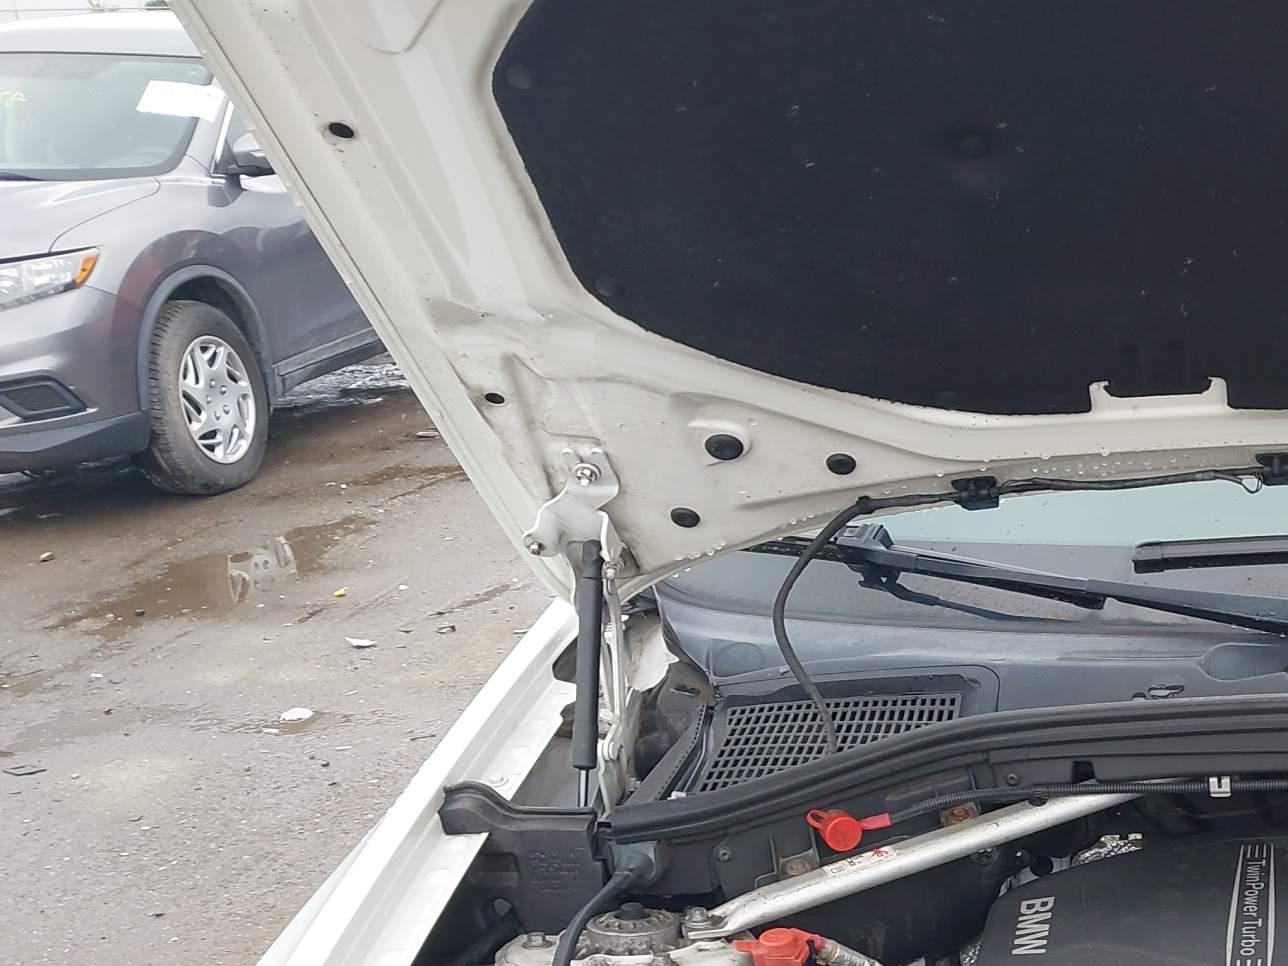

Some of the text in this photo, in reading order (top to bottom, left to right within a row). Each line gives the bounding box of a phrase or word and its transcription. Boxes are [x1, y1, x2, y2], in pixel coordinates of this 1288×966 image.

[1011, 896, 1055, 955] BMW
[1240, 859, 1266, 956] TwinPower Turbo
